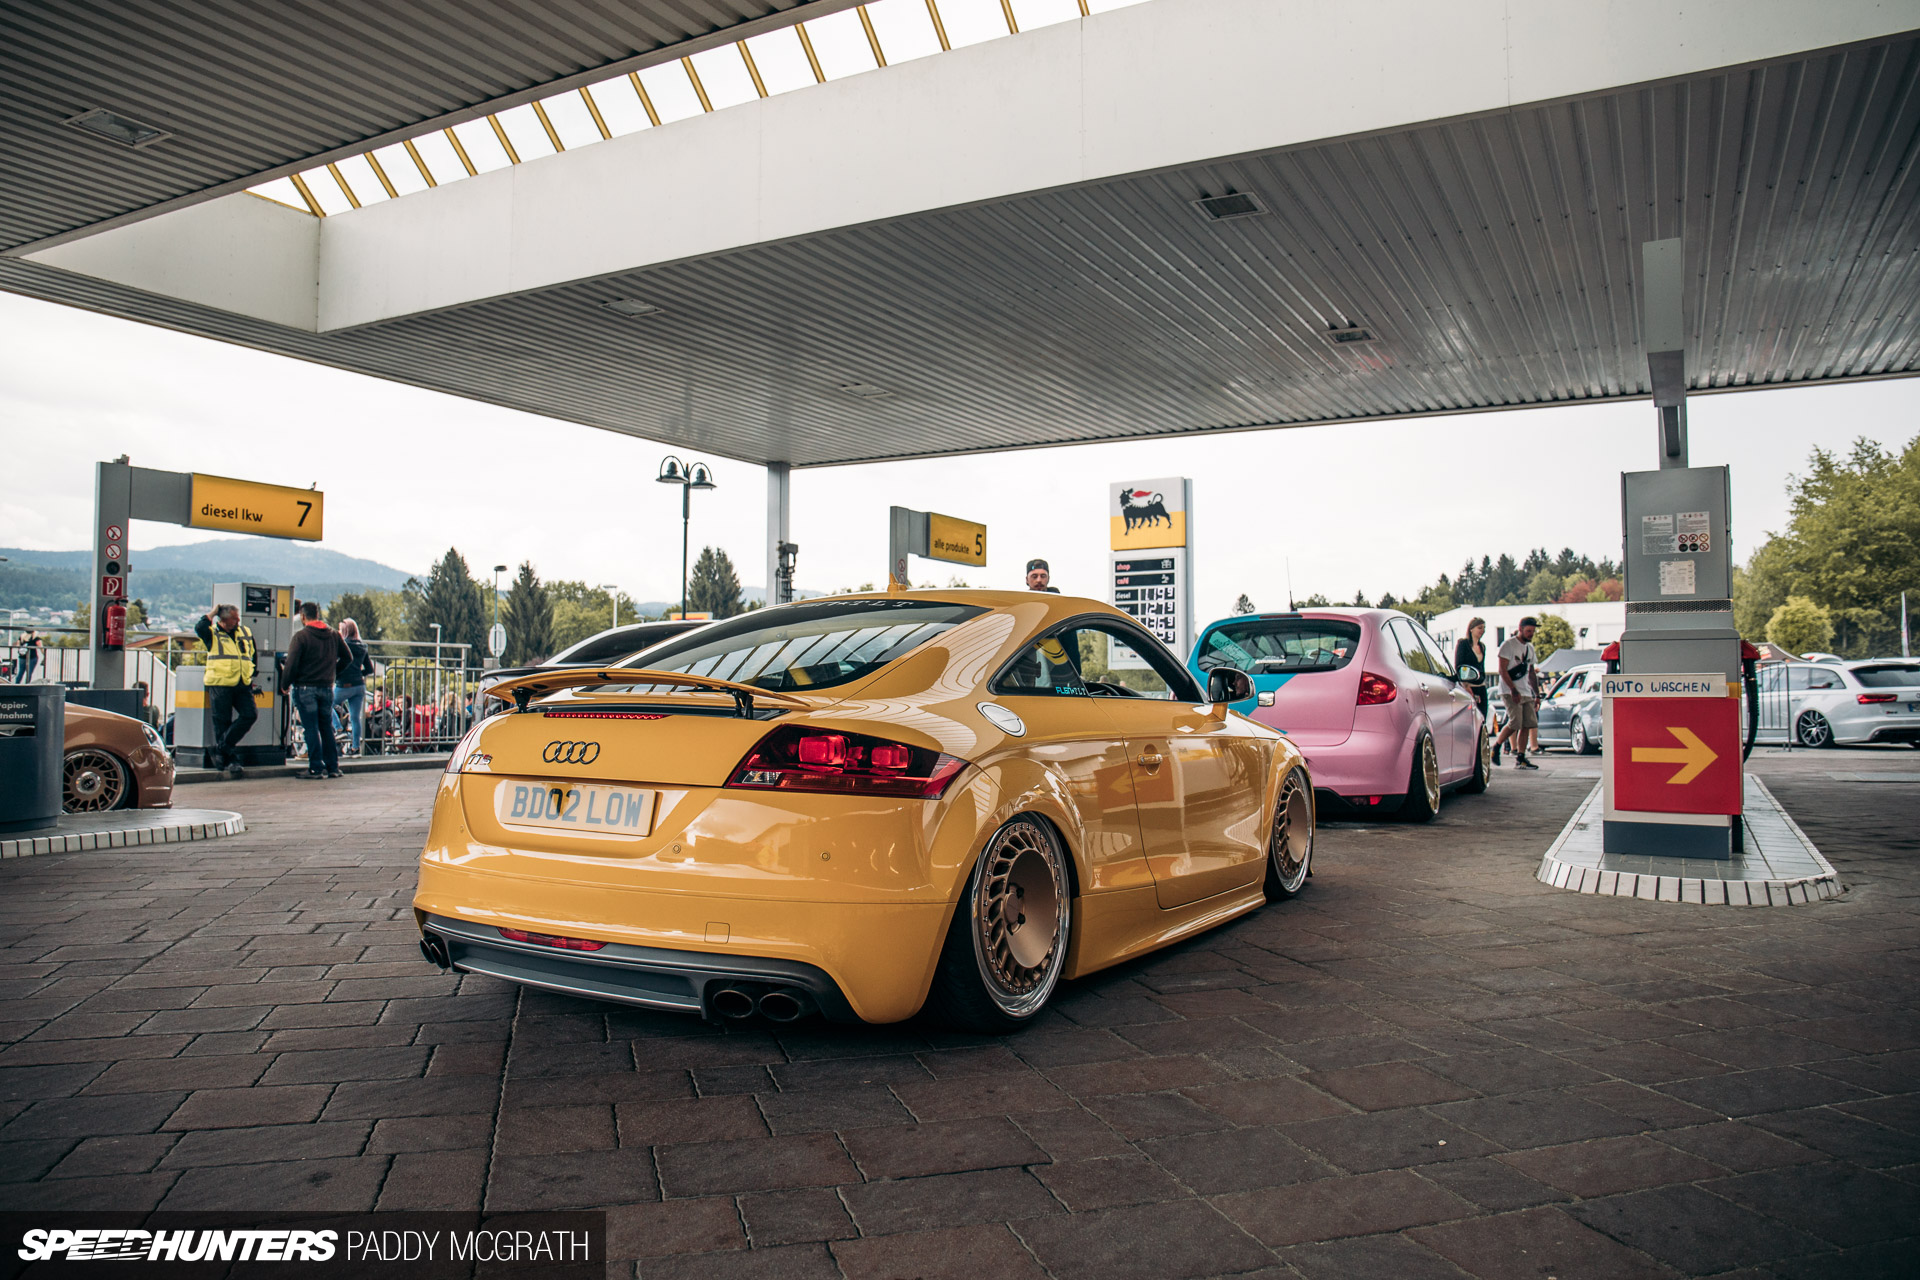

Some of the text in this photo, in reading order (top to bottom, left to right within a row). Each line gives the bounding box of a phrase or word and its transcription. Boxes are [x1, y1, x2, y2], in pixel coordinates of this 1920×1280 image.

[201, 503, 264, 522] diesel lkw
[296, 500, 313, 528] 7
[934, 538, 970, 555] alle produkte
[975, 533, 983, 557] 5
[1115, 592, 1131, 600] diesel
[1606, 680, 1711, 694] AUTO WASCHEN
[0, 701, 28, 711] apier-
[467, 753, 493, 766] TTS
[510, 785, 644, 828] BD02 LOW
